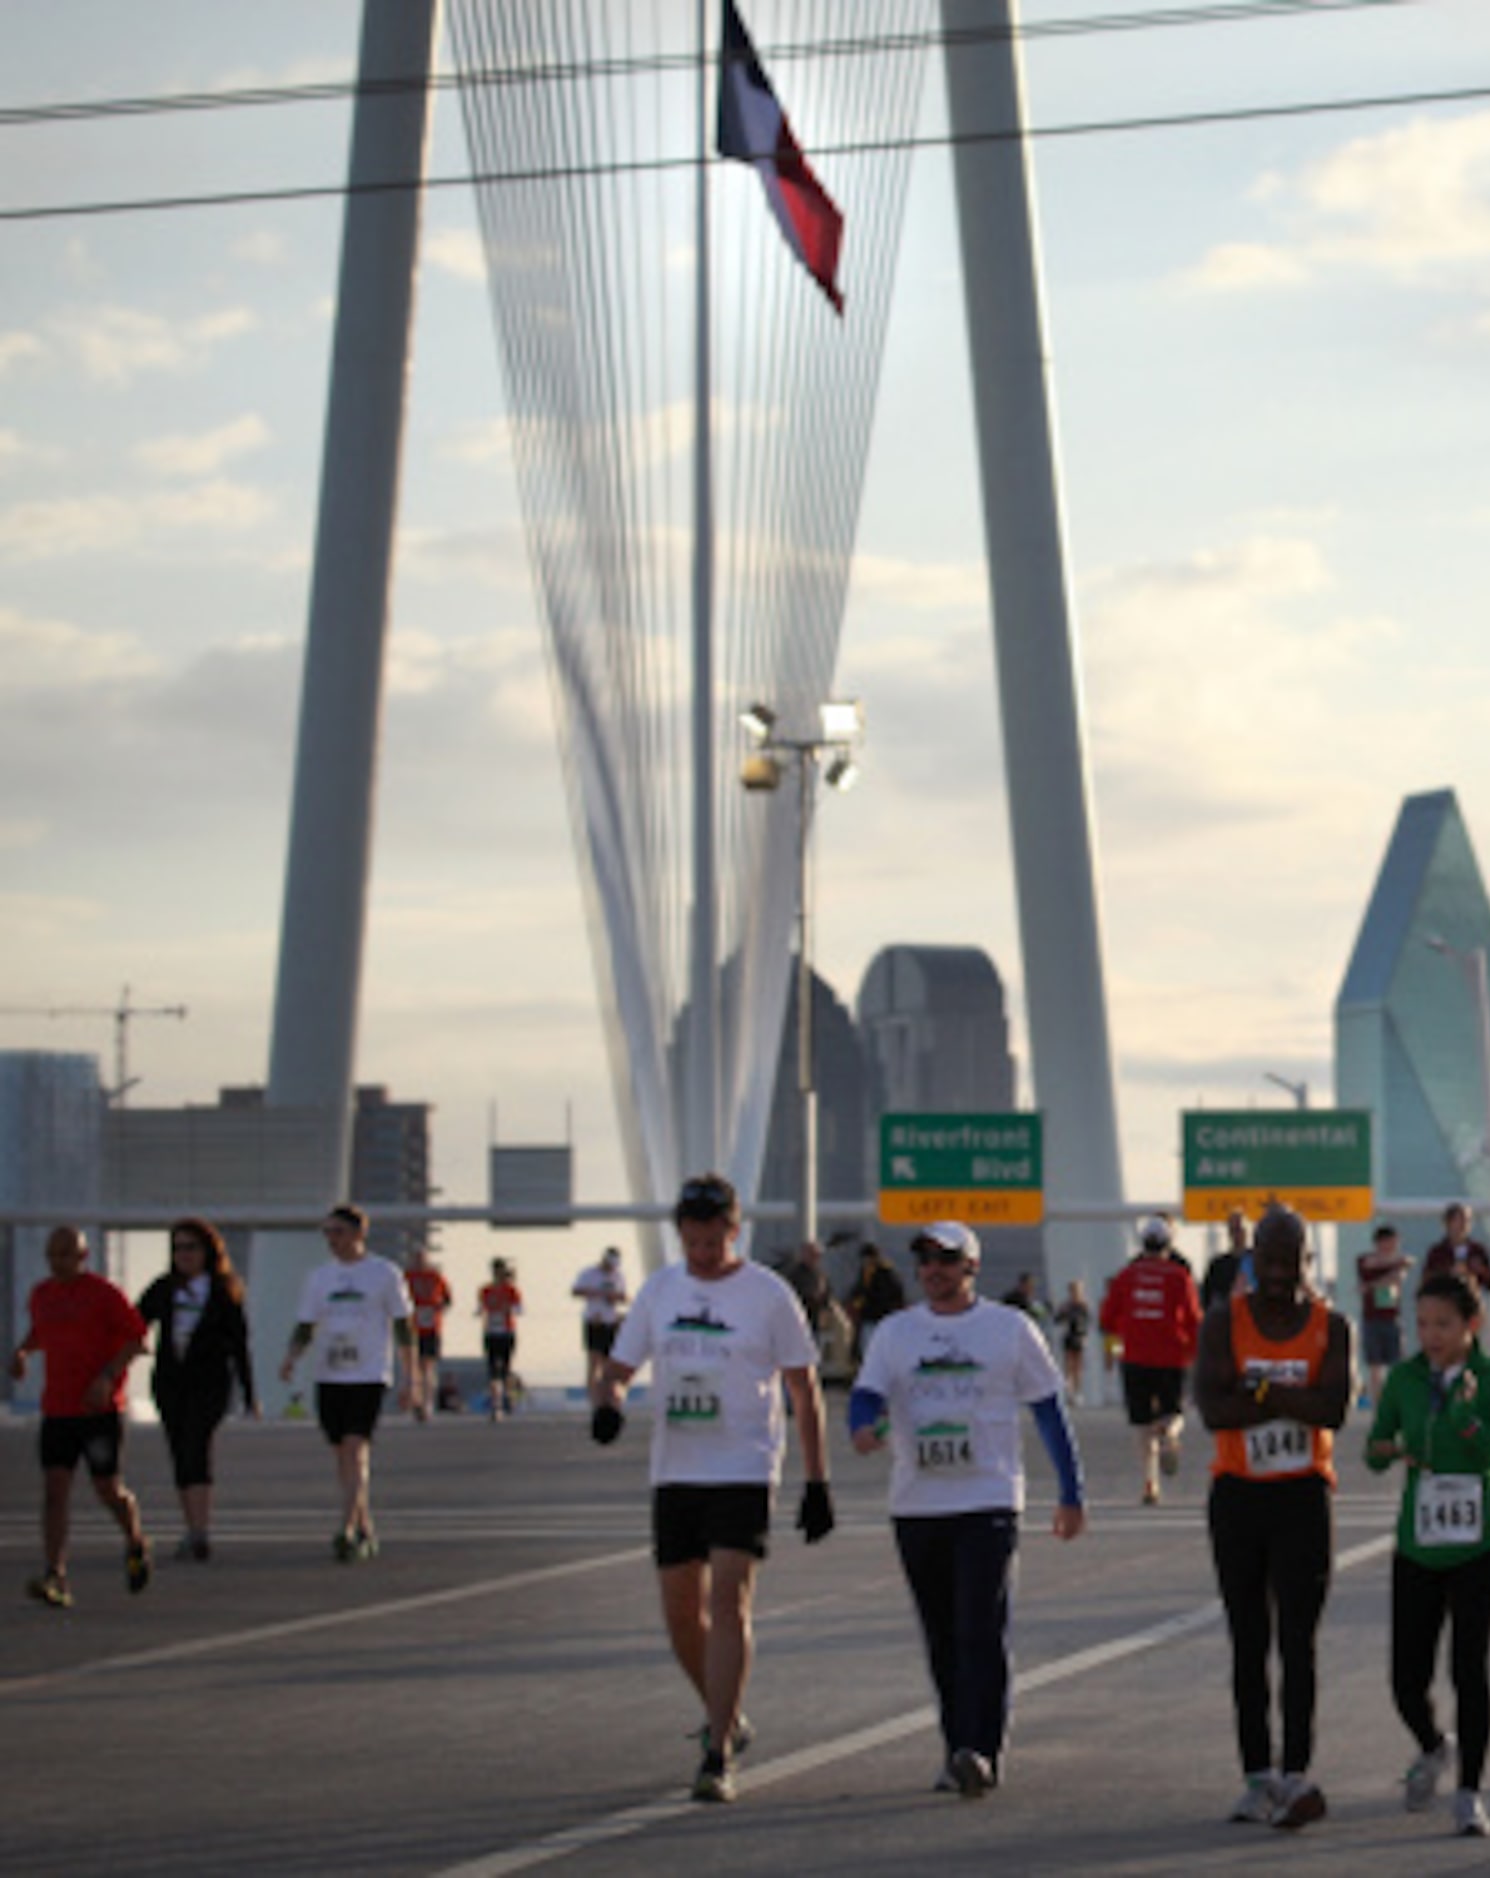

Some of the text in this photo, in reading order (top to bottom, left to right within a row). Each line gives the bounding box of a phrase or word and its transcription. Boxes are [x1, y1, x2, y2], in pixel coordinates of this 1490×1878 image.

[890, 1124, 1031, 1150] Riverfront
[1196, 1124, 1358, 1150] Continental
[972, 1156, 1031, 1181] Blvd
[1197, 1157, 1246, 1178] Ave
[908, 1197, 1011, 1217] LEFT EXIT
[916, 1436, 972, 1469] 1614
[1419, 1499, 1478, 1534] 1463
